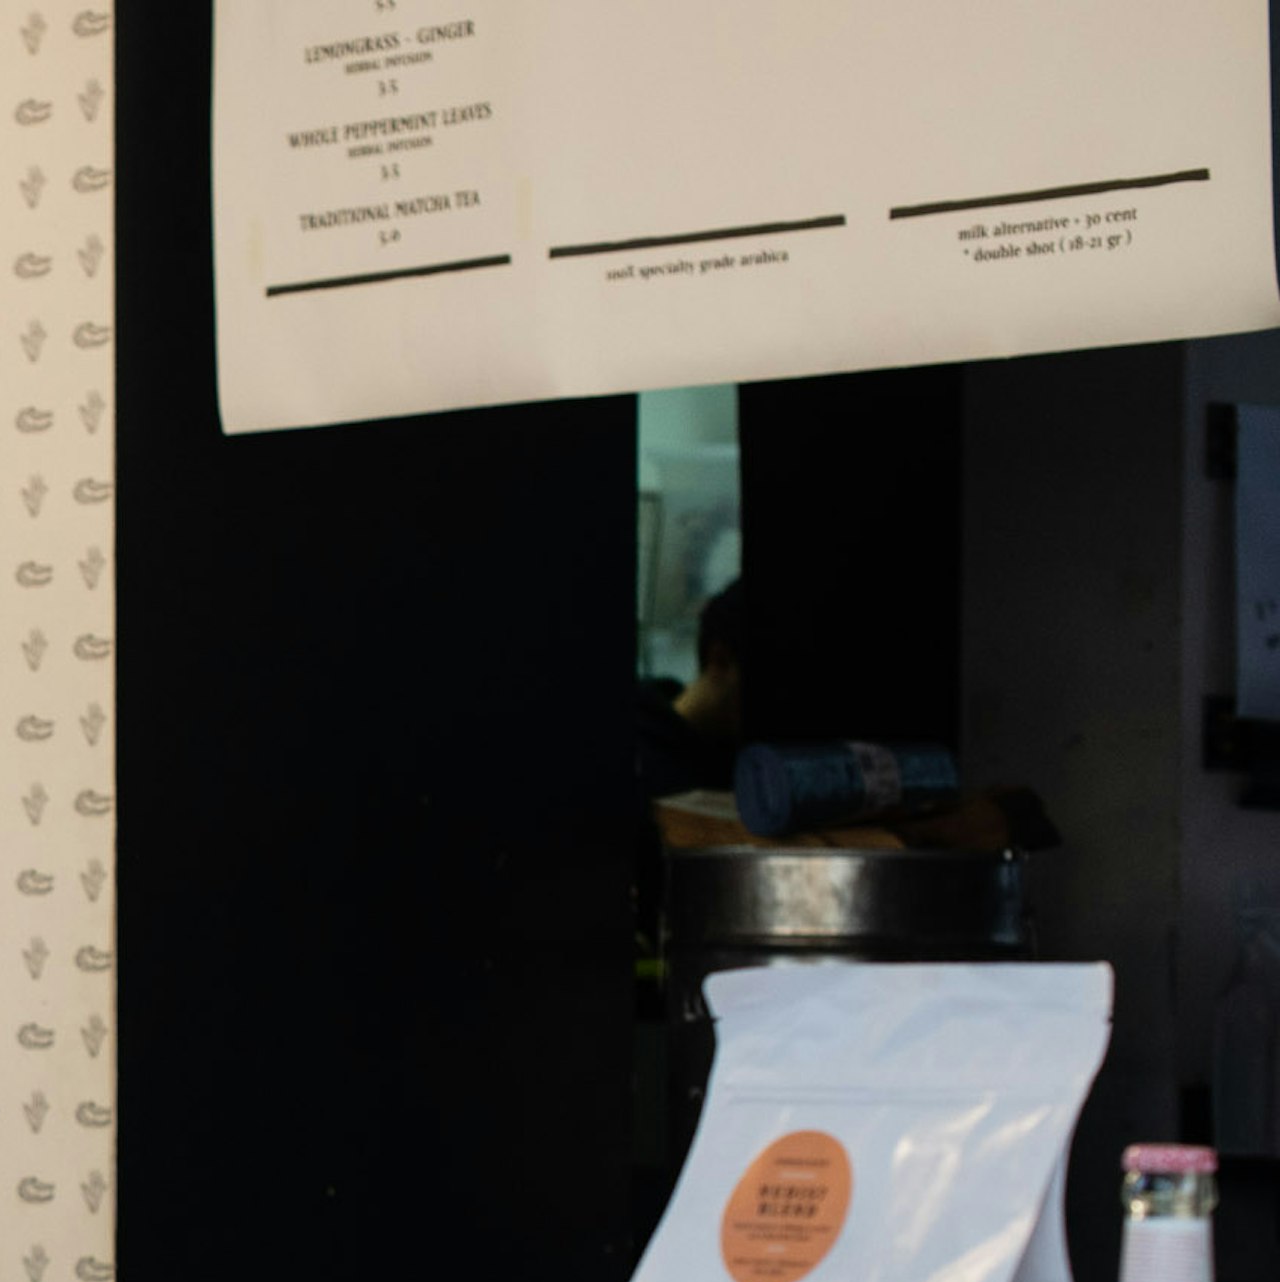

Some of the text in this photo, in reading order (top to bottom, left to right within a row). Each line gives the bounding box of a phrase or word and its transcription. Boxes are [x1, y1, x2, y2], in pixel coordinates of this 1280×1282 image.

[304, 34, 400, 64] LEMONGRASS
[415, 19, 476, 45] GINGER
[287, 101, 493, 148] WHOLE PEPPERMINT LEAVES
[299, 190, 481, 231] TRADITIONAL MATCHA TEA
[958, 224, 989, 241] milk
[993, 215, 1070, 237] alternative
[1105, 208, 1138, 221] cent
[700, 254, 736, 272] grade
[740, 250, 790, 266] arabica
[973, 247, 1021, 262] double
[1025, 241, 1055, 256] shot
